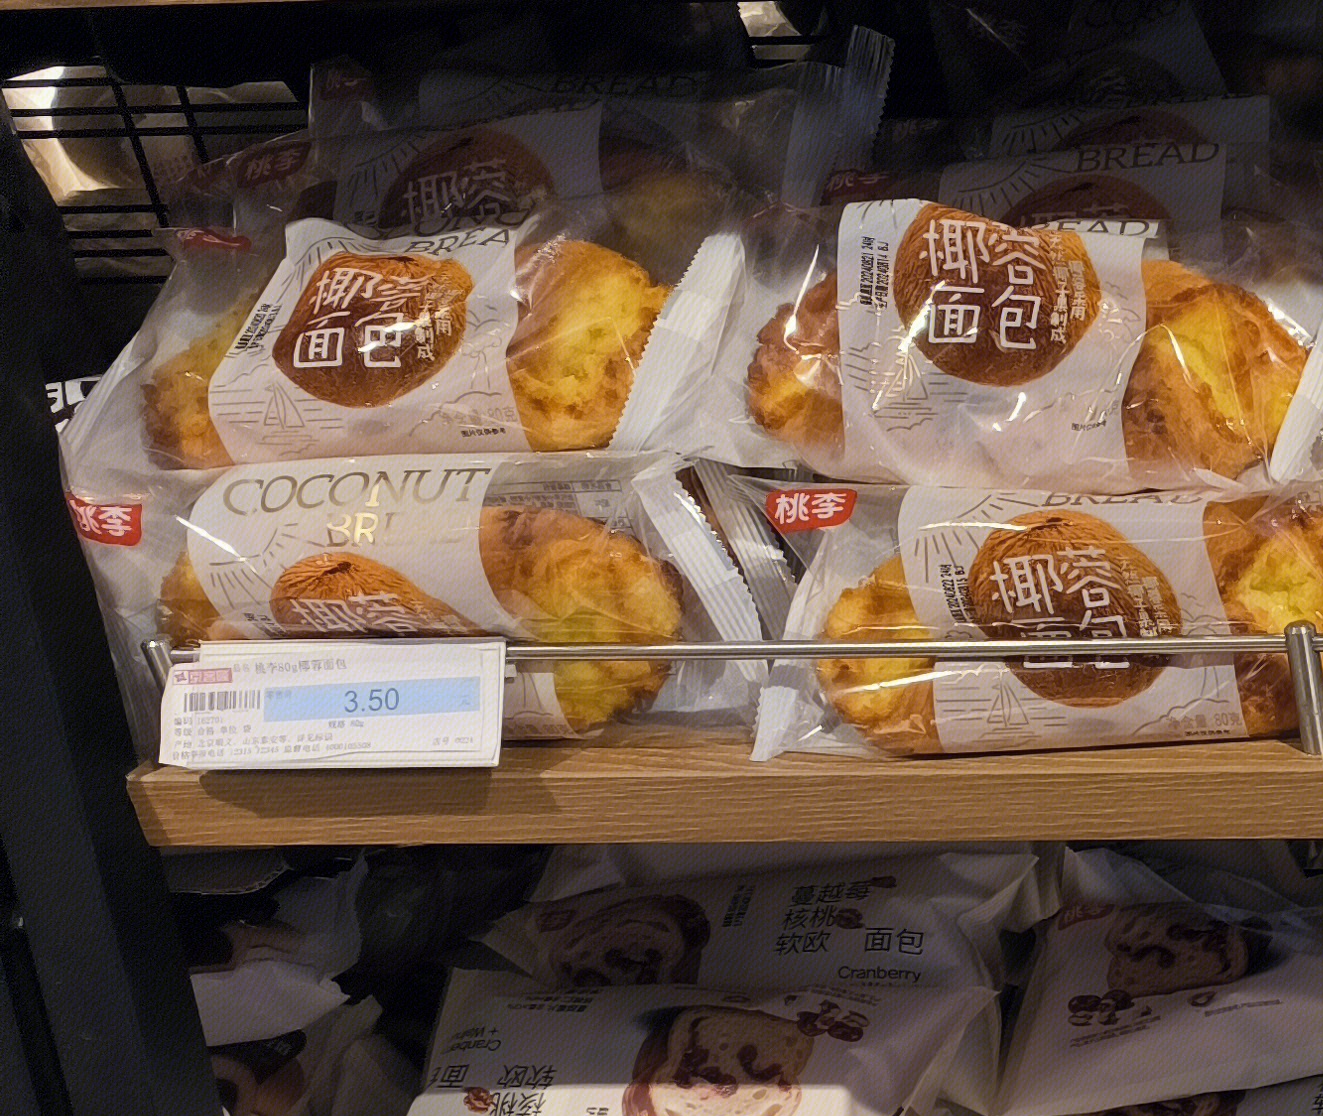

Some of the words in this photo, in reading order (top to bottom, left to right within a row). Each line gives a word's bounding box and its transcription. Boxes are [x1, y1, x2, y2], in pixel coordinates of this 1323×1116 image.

[1076, 143, 1221, 173] BREAD
[928, 285, 1042, 349] 面包
[222, 468, 492, 517] COCONUT
[774, 493, 847, 523] 桃李
[991, 547, 1122, 614] 椰蓉
[343, 687, 400, 713] 3.50
[790, 881, 872, 906] 蔓越莓
[782, 906, 837, 931] 核桃
[774, 931, 830, 955] 软欧
[863, 927, 925, 955] 面包
[838, 965, 922, 982] Cranberry
